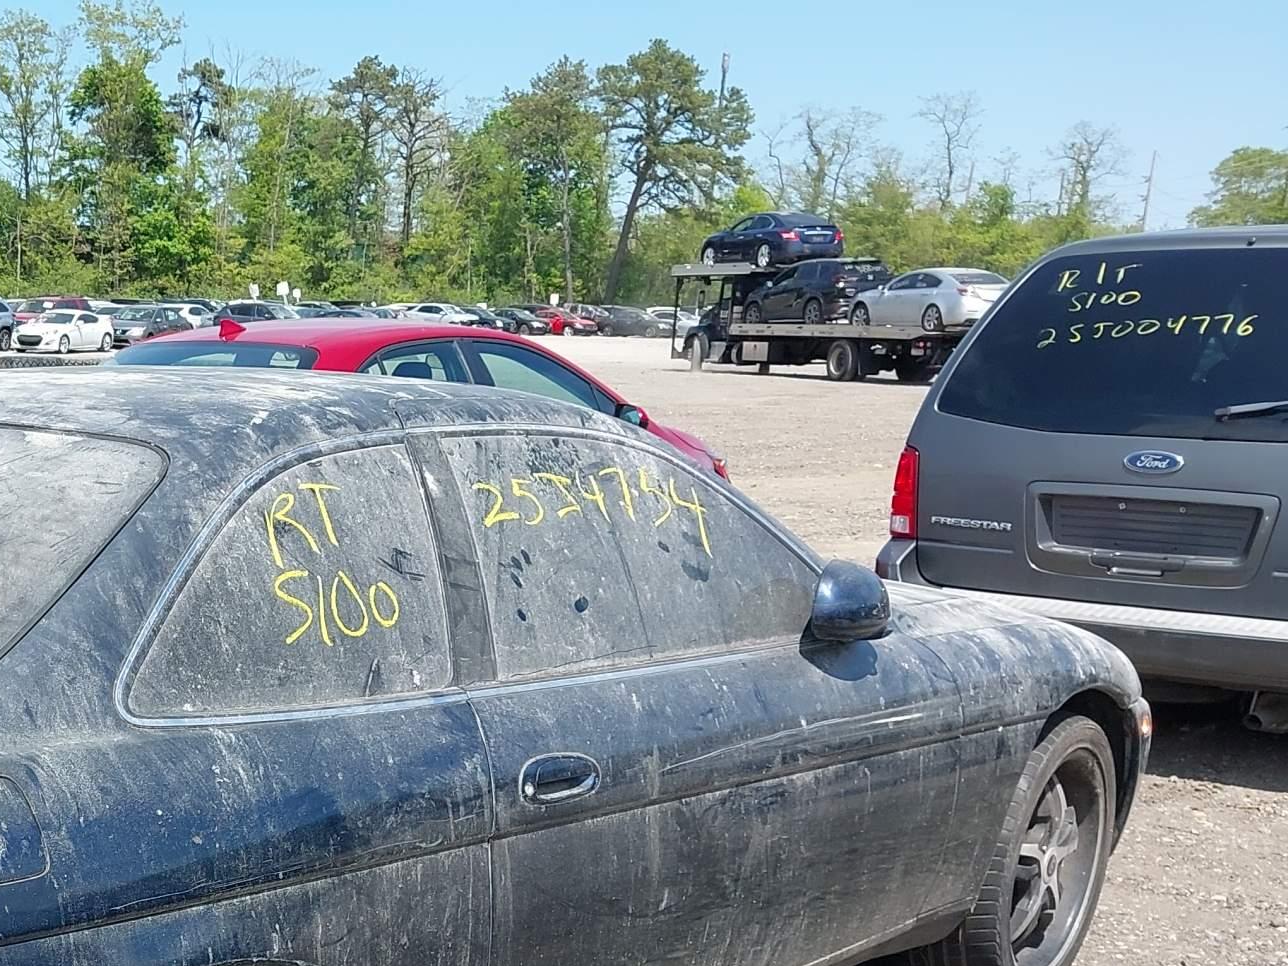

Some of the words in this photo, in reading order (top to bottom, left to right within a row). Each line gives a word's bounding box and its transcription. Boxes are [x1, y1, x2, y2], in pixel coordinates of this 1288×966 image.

[1068, 290, 1142, 312] S100
[1135, 453, 1171, 470] Ford
[263, 483, 342, 569] RT
[930, 515, 1012, 531] FREESTAR
[273, 570, 400, 647] S100
